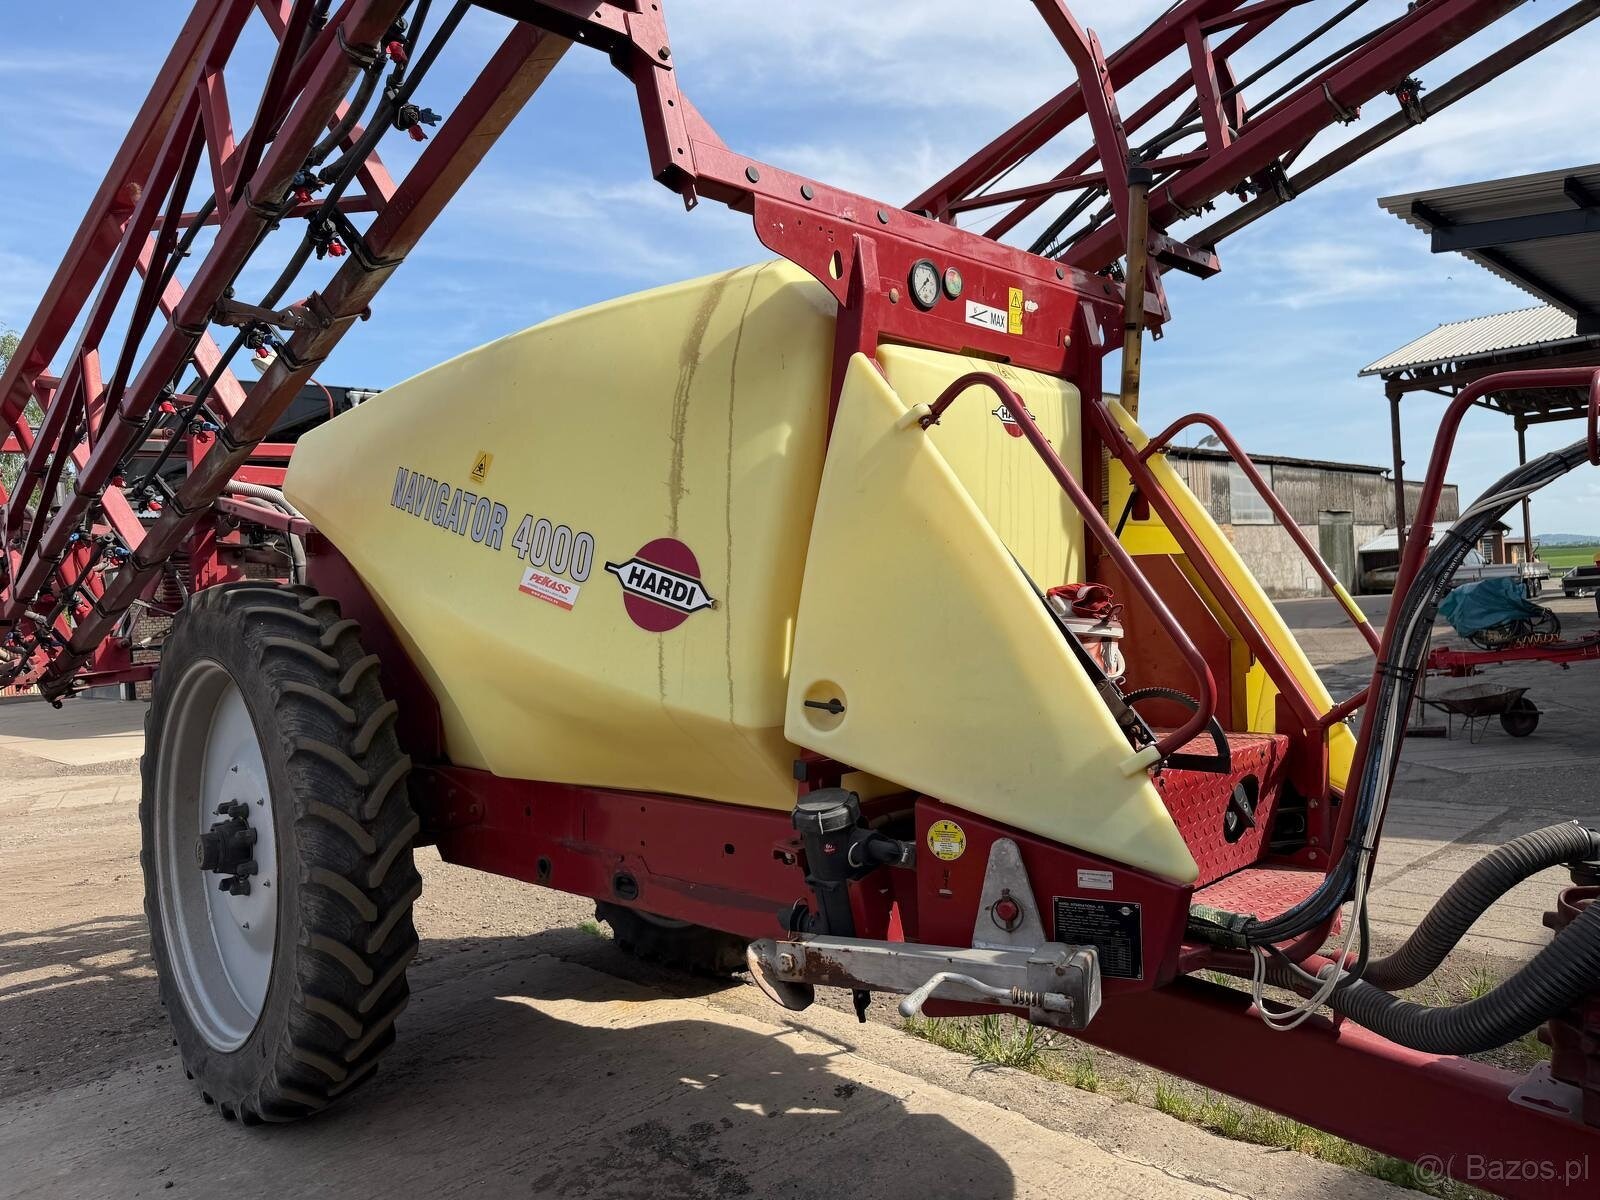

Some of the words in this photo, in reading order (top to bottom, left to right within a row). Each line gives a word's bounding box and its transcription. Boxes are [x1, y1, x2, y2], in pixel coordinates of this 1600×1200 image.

[990, 312, 1005, 328] MAX
[391, 466, 508, 551] NAVIGATOR
[511, 514, 595, 583] 4000
[628, 566, 697, 606] HARDI
